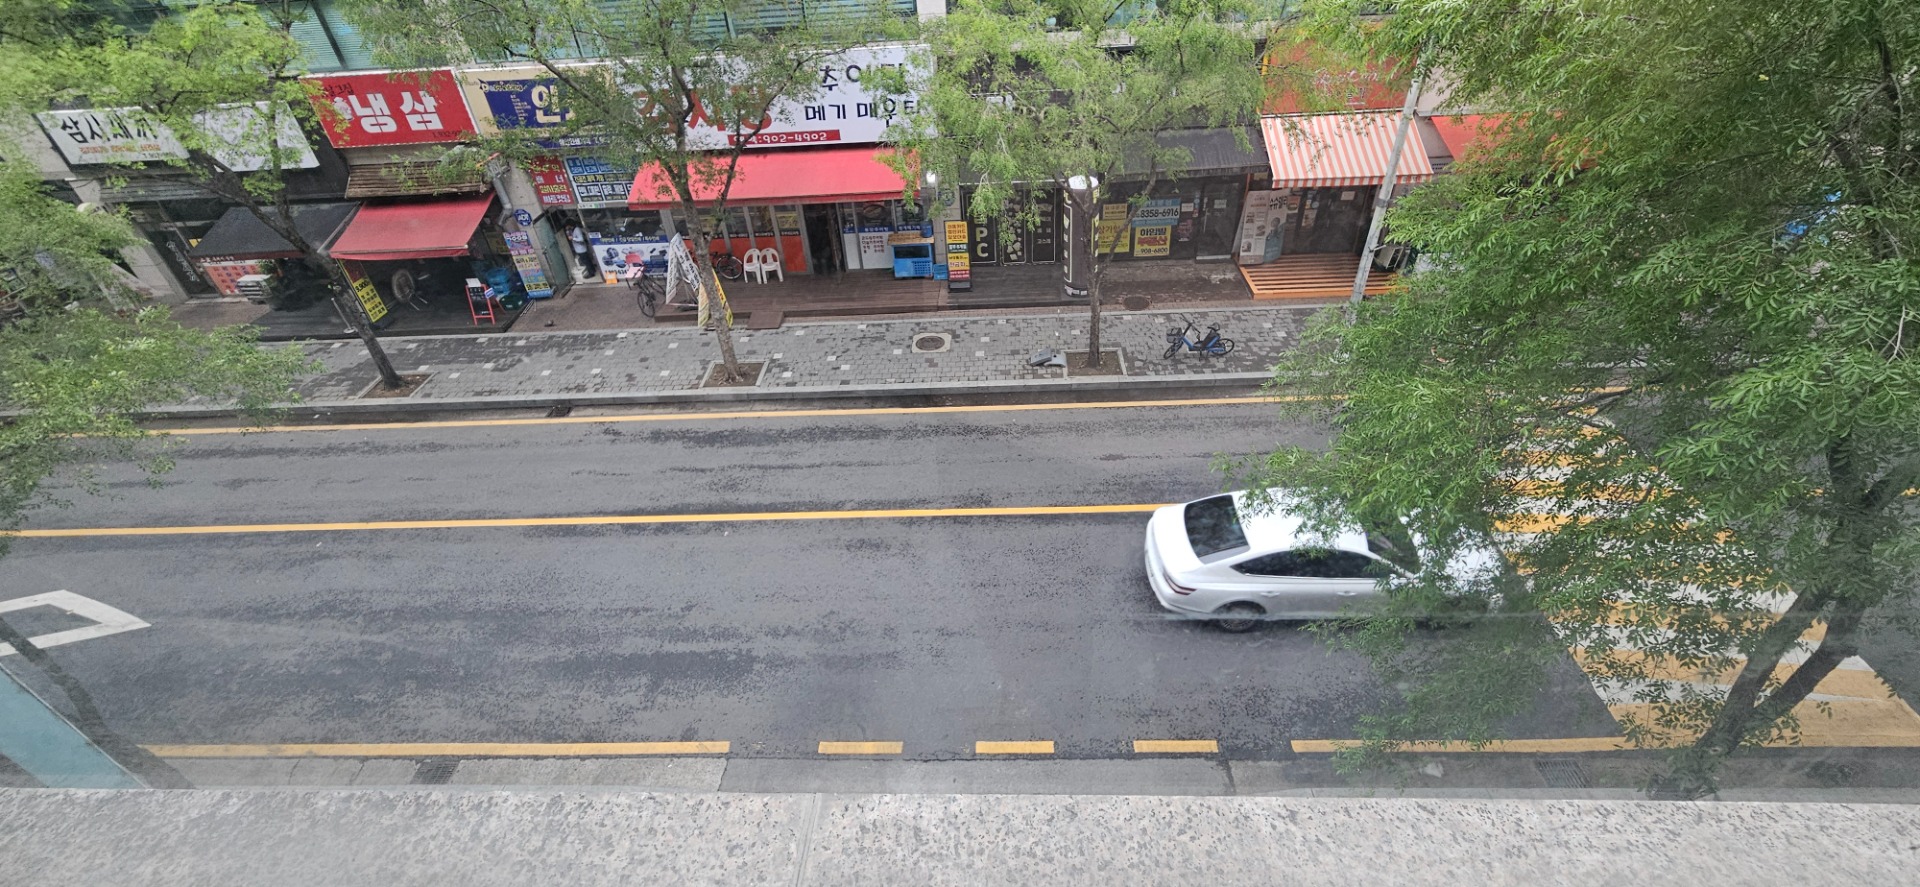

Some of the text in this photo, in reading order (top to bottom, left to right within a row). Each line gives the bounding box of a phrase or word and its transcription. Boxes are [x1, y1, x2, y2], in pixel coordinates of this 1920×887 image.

[820, 64, 907, 95] 추어
[347, 90, 444, 134] 냉삼
[804, 103, 846, 120] 메기
